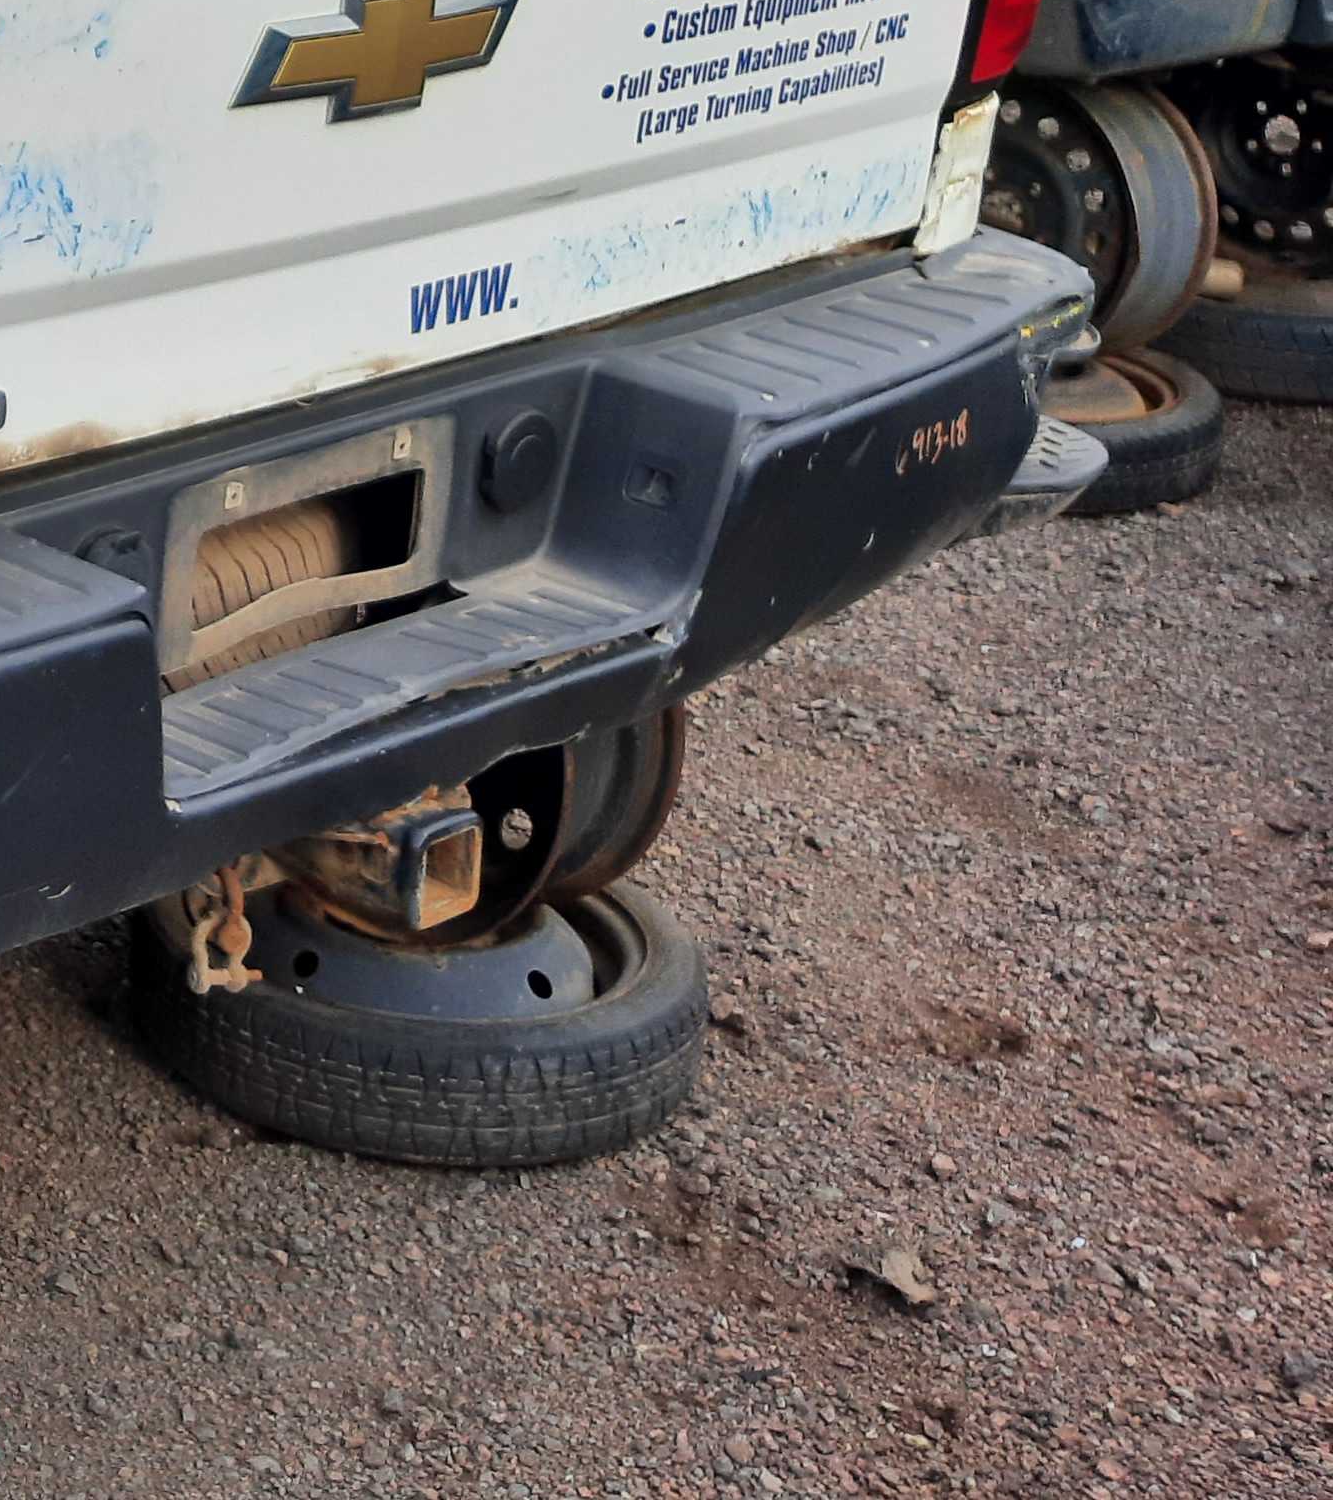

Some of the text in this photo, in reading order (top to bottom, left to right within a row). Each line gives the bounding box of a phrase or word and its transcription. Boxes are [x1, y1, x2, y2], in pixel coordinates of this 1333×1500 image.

[662, 3, 737, 44] Custom
[617, 68, 652, 103] Full
[657, 57, 729, 93] Service
[735, 38, 809, 77] Machine
[815, 19, 857, 59] Shop
[875, 13, 909, 44] CNC
[706, 86, 774, 124] Turning
